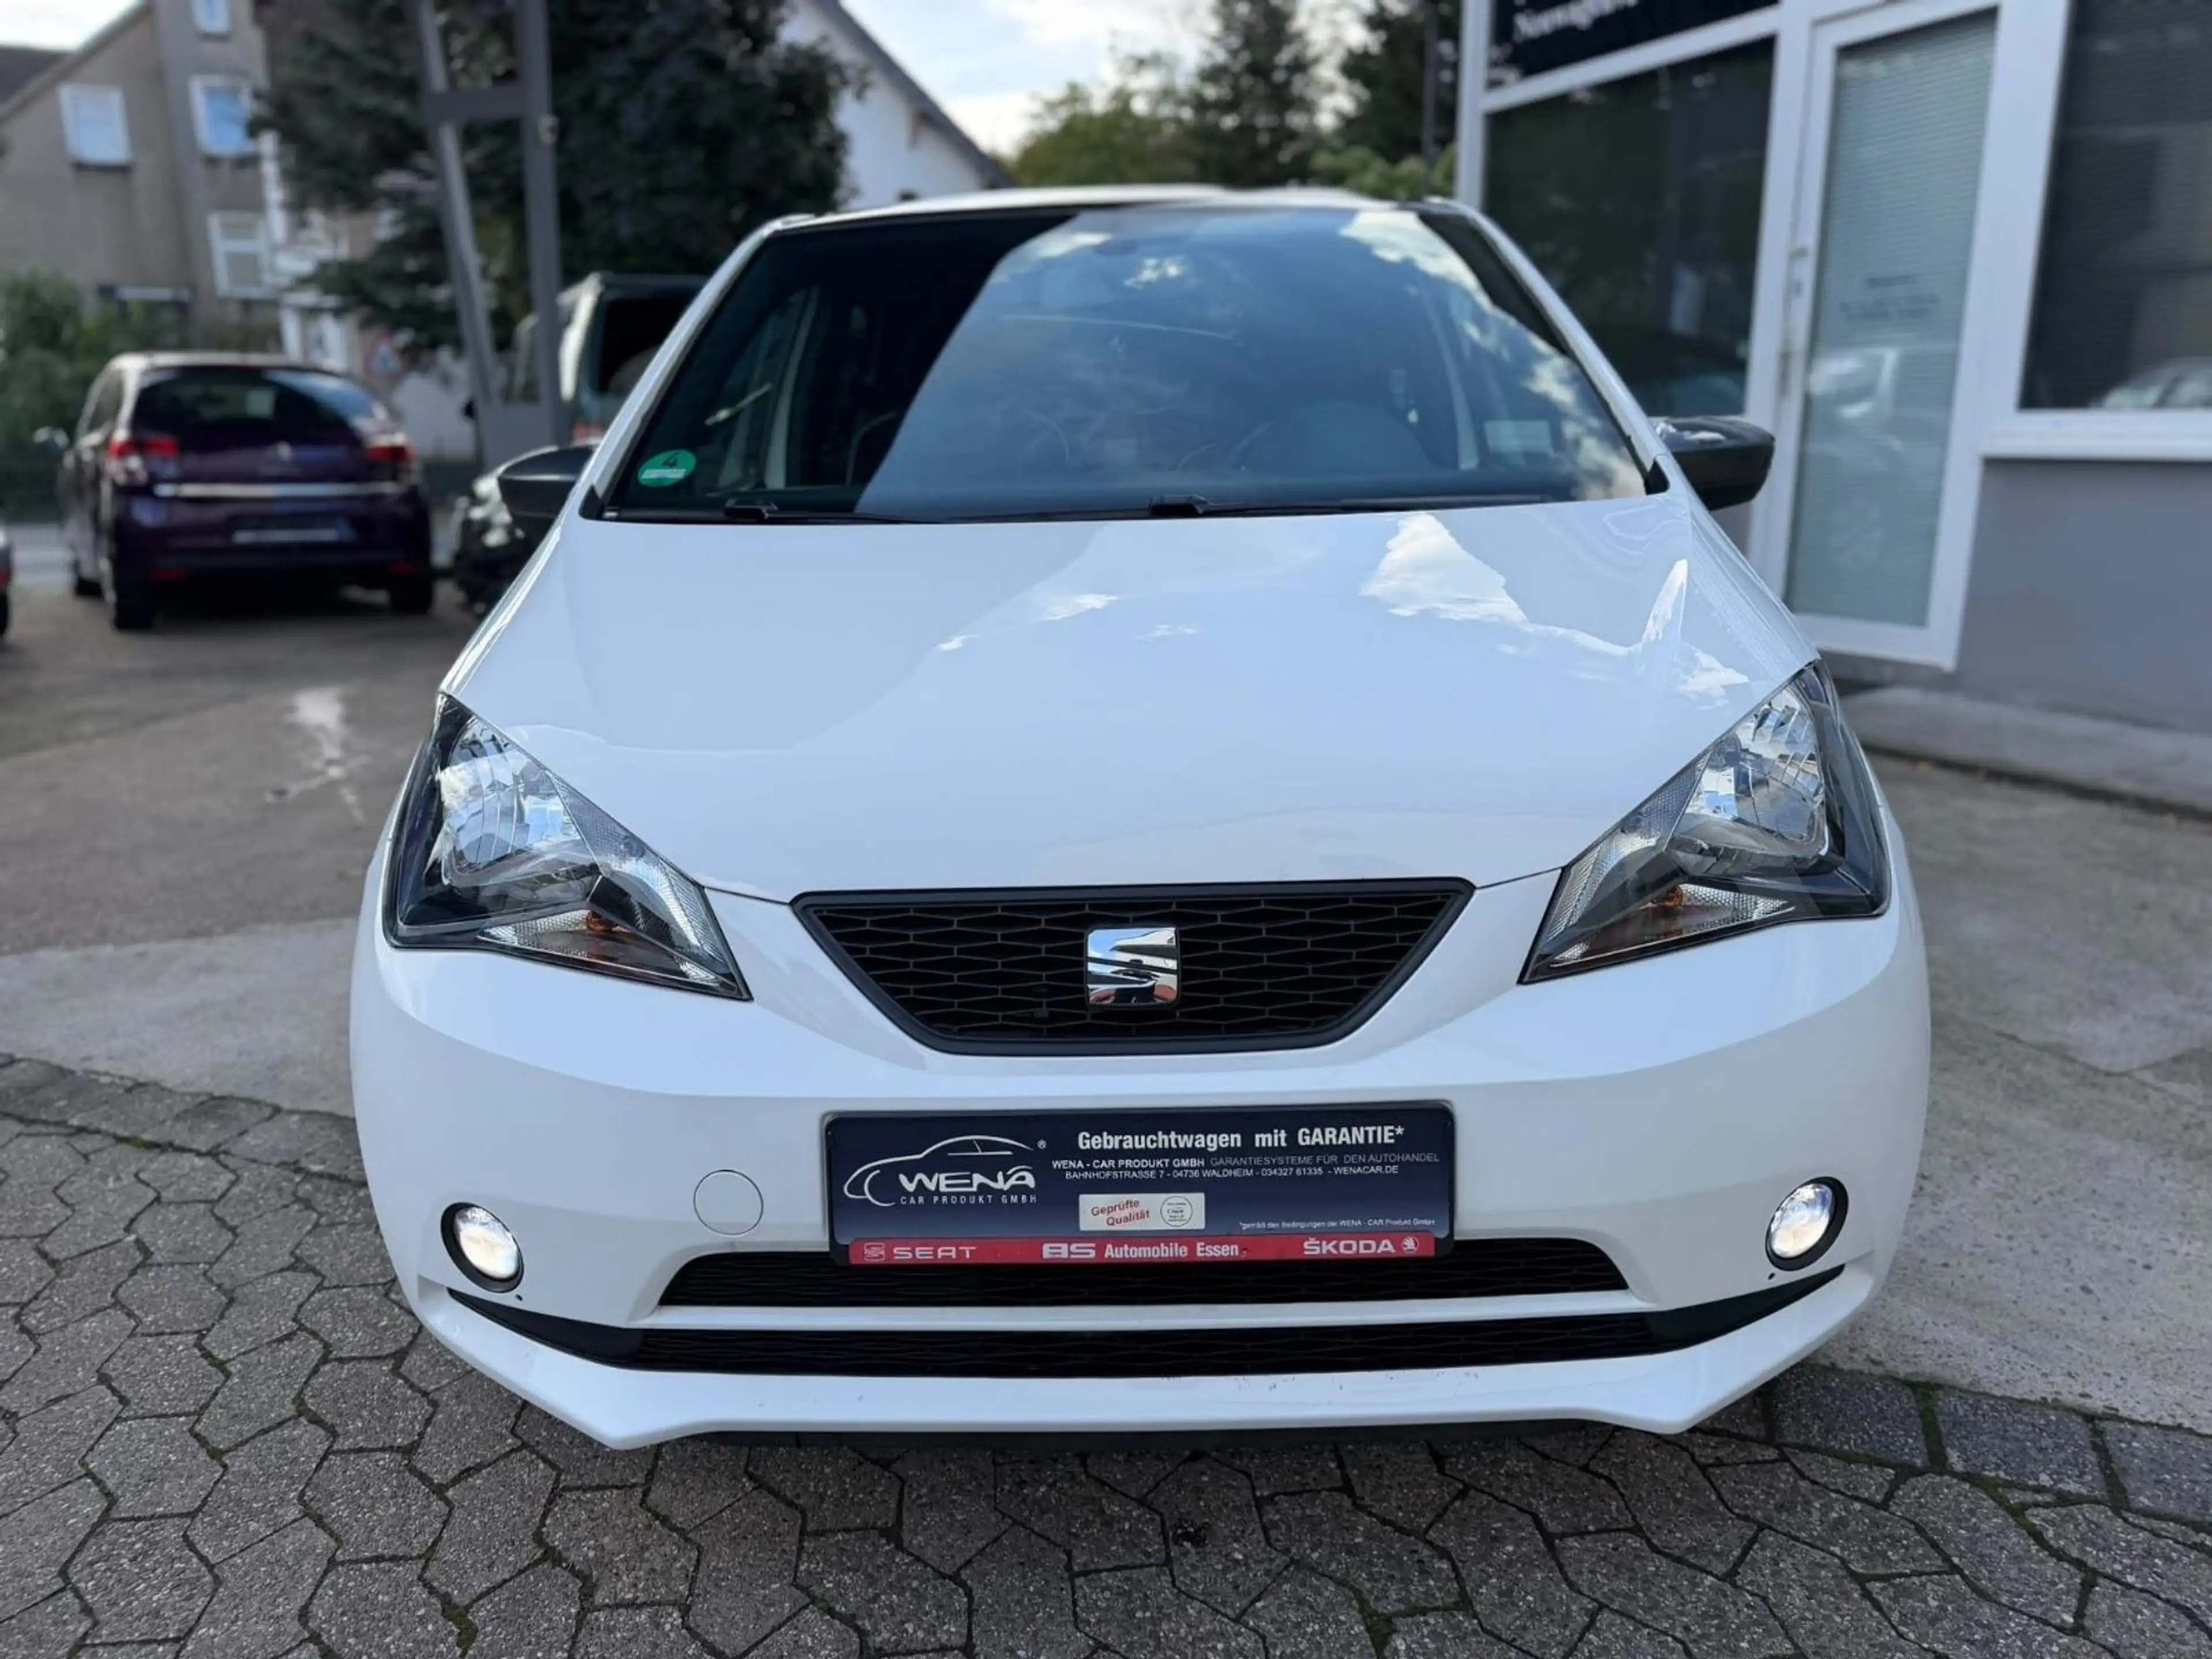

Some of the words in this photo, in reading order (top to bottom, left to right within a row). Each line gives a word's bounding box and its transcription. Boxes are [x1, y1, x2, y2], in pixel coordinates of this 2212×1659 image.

[1078, 1131, 1241, 1152] Gebrauchtwagen
[1255, 1128, 1287, 1147] mit
[1052, 1160, 1084, 1169] WENA
[1092, 1160, 1115, 1169] CAR
[1118, 1158, 1170, 1168] PRODUKT
[1172, 1158, 1205, 1168] GMBH
[1210, 1156, 1313, 1166] GARANTIESYSTEME
[1316, 1153, 1338, 1165] FÜR
[1343, 1154, 1366, 1164] DEN
[1368, 1153, 1440, 1162] AUTOHANDEL
[899, 1168, 1035, 1192] WENA
[1066, 1170, 1157, 1180] BAHNHOFSTRASSE
[1160, 1170, 1164, 1179] 7
[1202, 1168, 1253, 1177] WALDHEIM
[900, 1195, 925, 1205] CAR
[933, 1194, 993, 1205] PRODUKT
[1001, 1194, 1037, 1204] GMBH
[1091, 1199, 1140, 1215] Geprüfte
[1106, 1210, 1150, 1226] Qualität
[893, 1246, 977, 1259] SEAT
[1104, 1243, 1188, 1258] Automobile
[1196, 1241, 1238, 1257] Essen
[1303, 1237, 1396, 1255] ŠKODA
